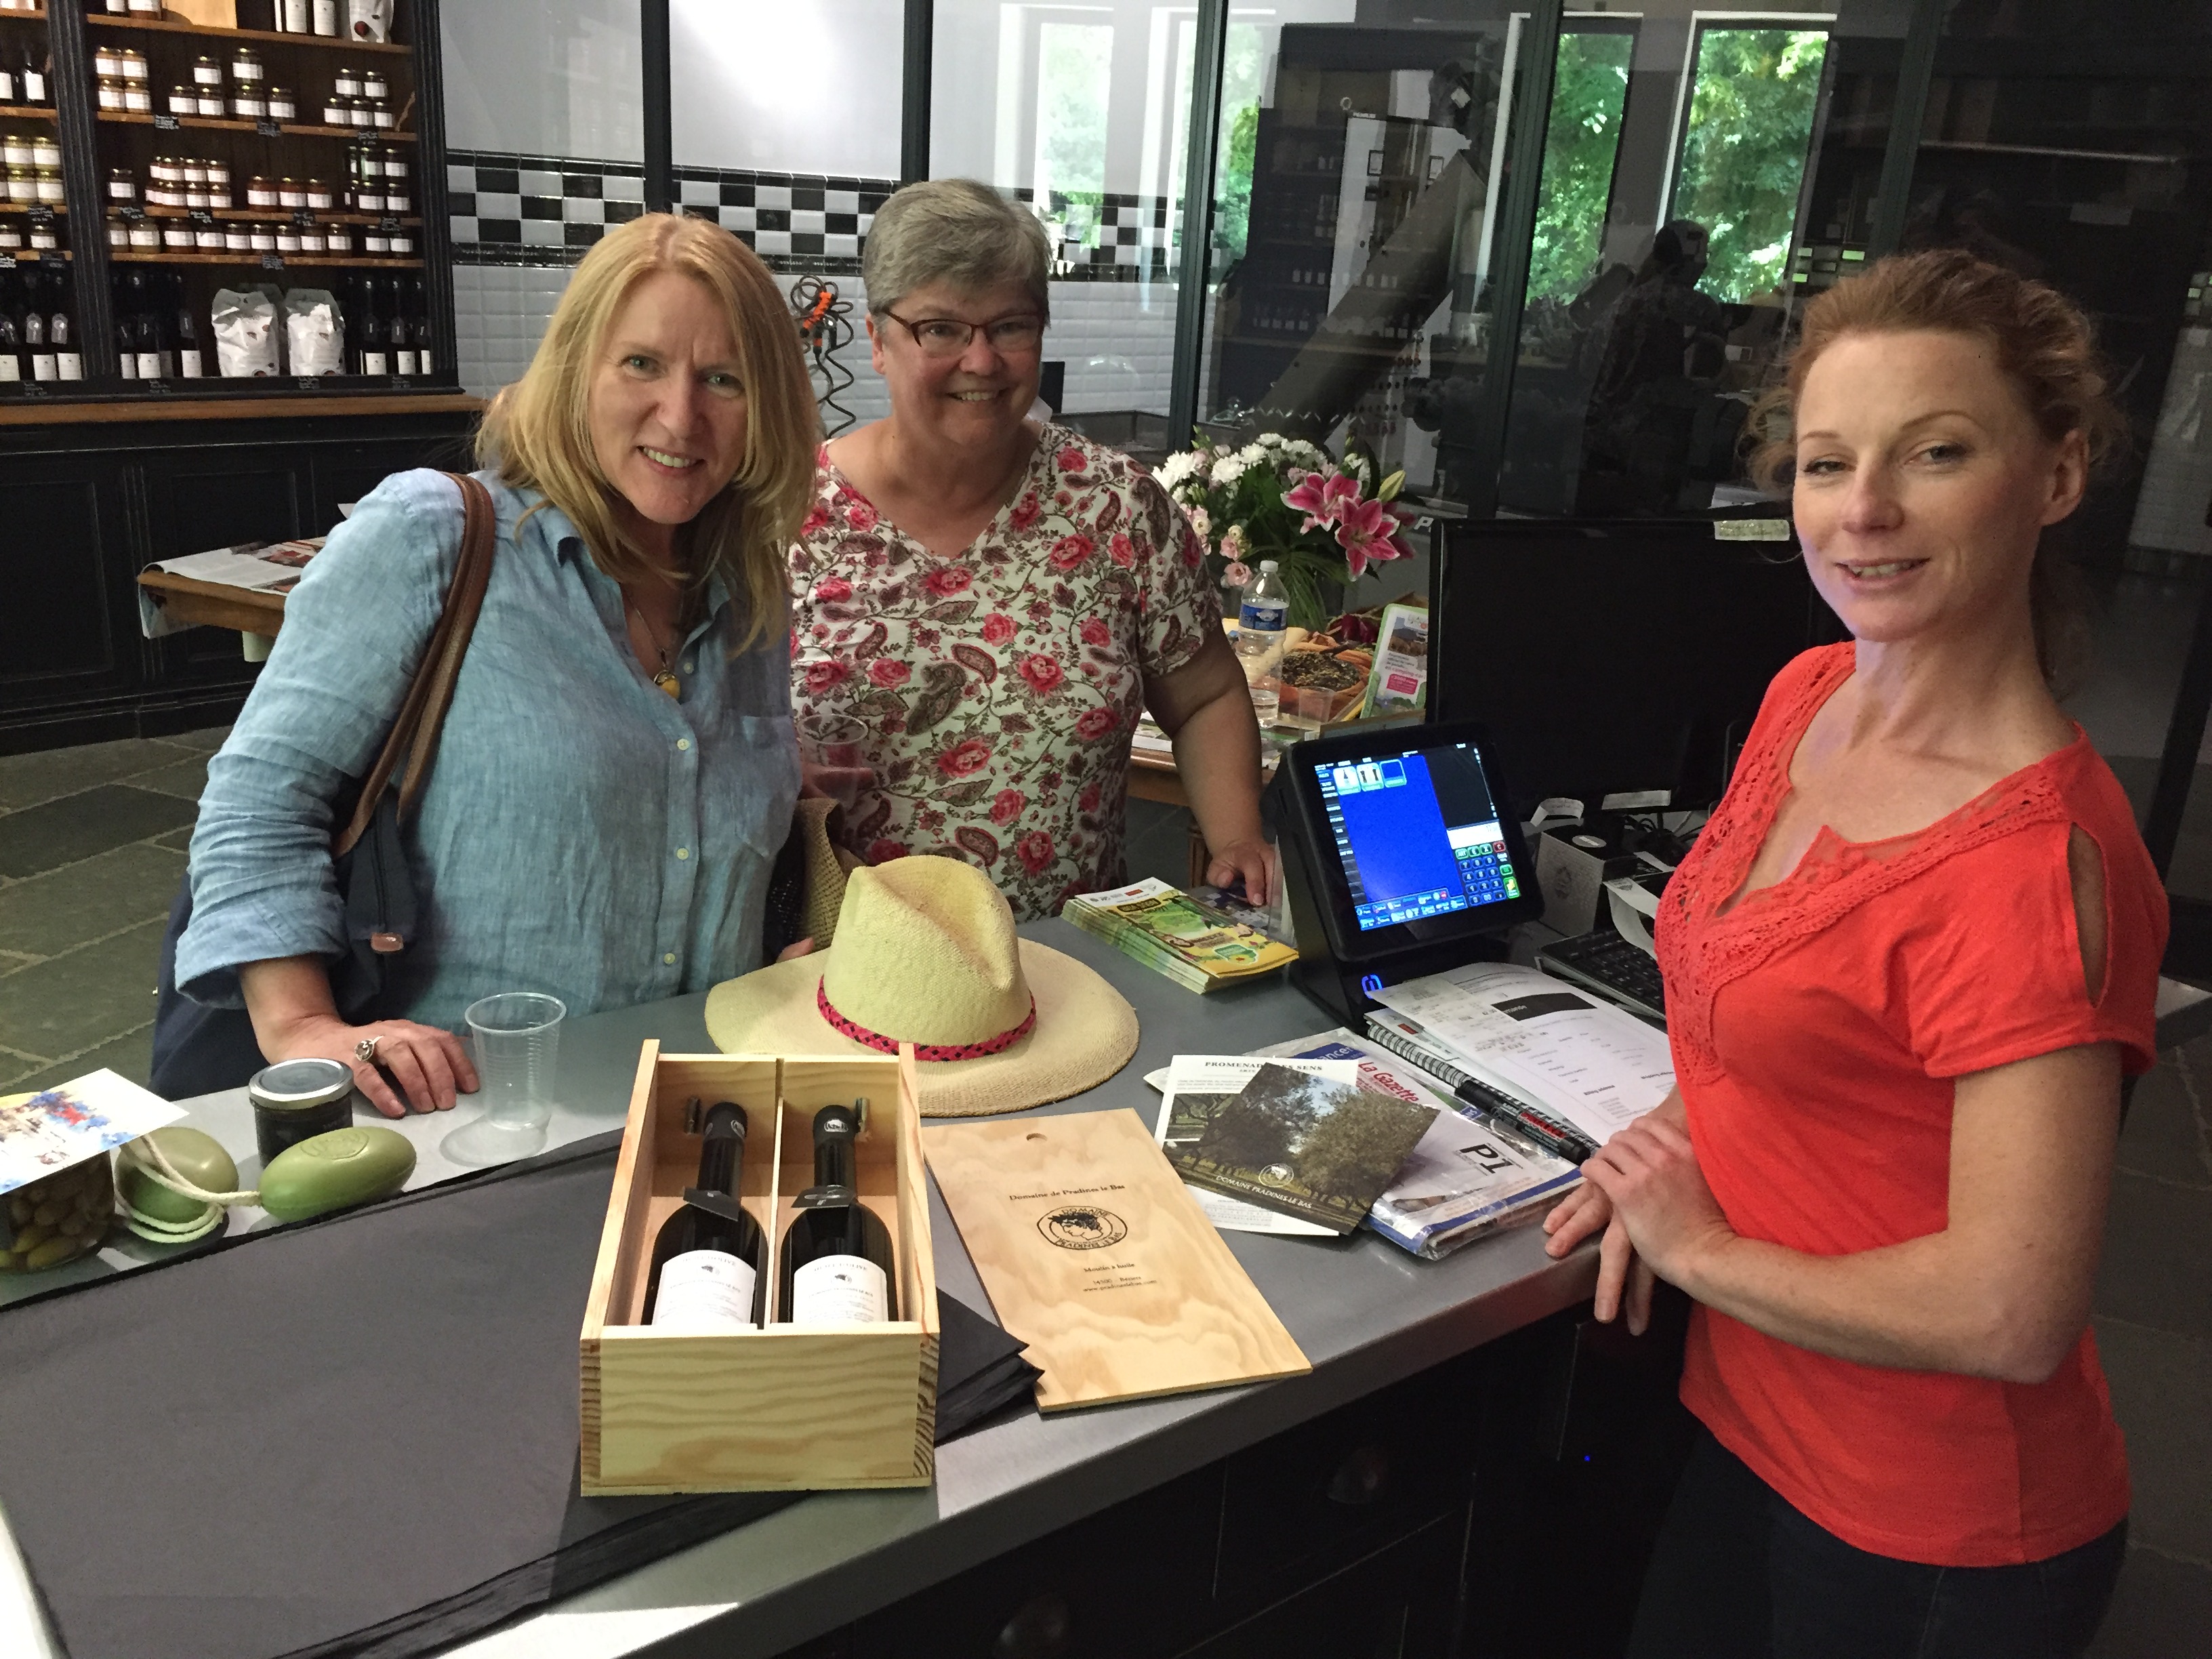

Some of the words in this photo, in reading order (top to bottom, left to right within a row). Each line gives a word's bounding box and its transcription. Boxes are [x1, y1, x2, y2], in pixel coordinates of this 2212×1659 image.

[1358, 1062, 1377, 1072] La
[1374, 1073, 1419, 1102] Gazette
[1216, 1175, 1252, 1190] DOMAINE
[1252, 1186, 1288, 1201] PRADINES
[1288, 1196, 1298, 1204] LE
[1298, 1200, 1312, 1209] BAS
[1061, 1208, 1110, 1218] DOMAINE
